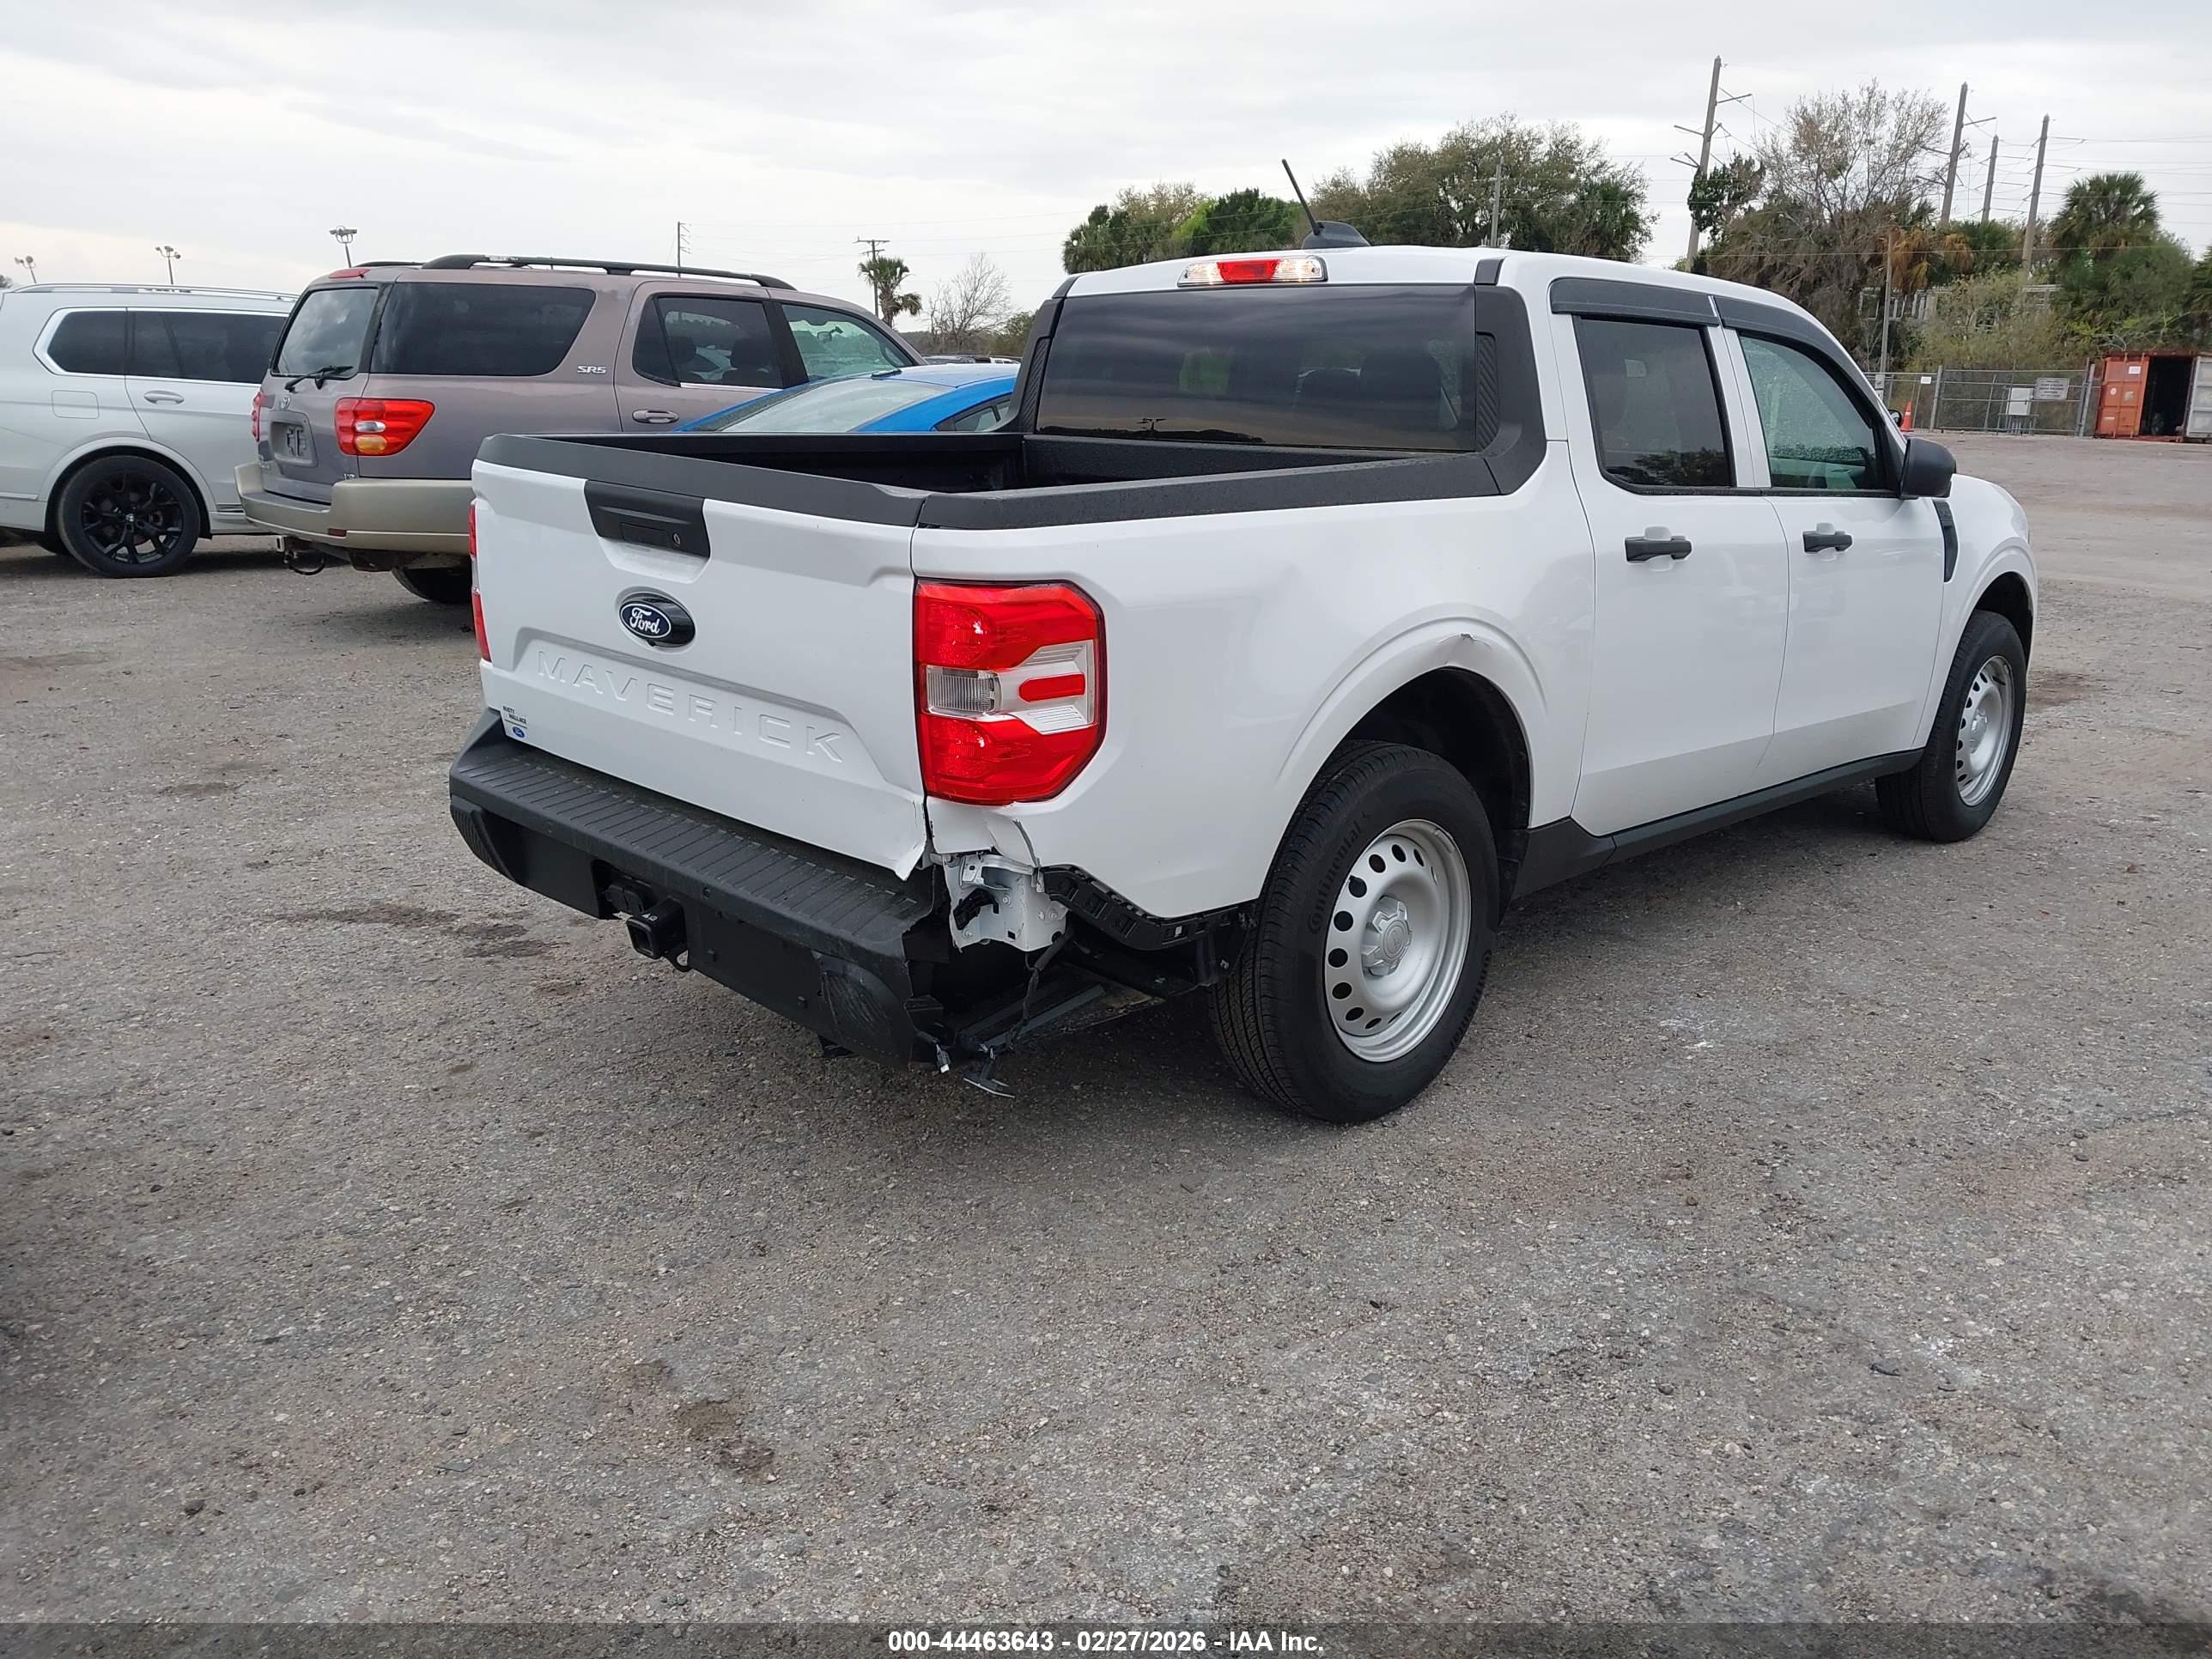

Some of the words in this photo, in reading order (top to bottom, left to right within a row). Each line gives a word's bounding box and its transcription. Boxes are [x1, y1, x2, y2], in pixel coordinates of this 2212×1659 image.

[577, 365, 606, 374] SR5
[629, 606, 660, 635] Ford
[537, 651, 843, 763] MAVERICK
[1308, 819, 1363, 935] Continental
